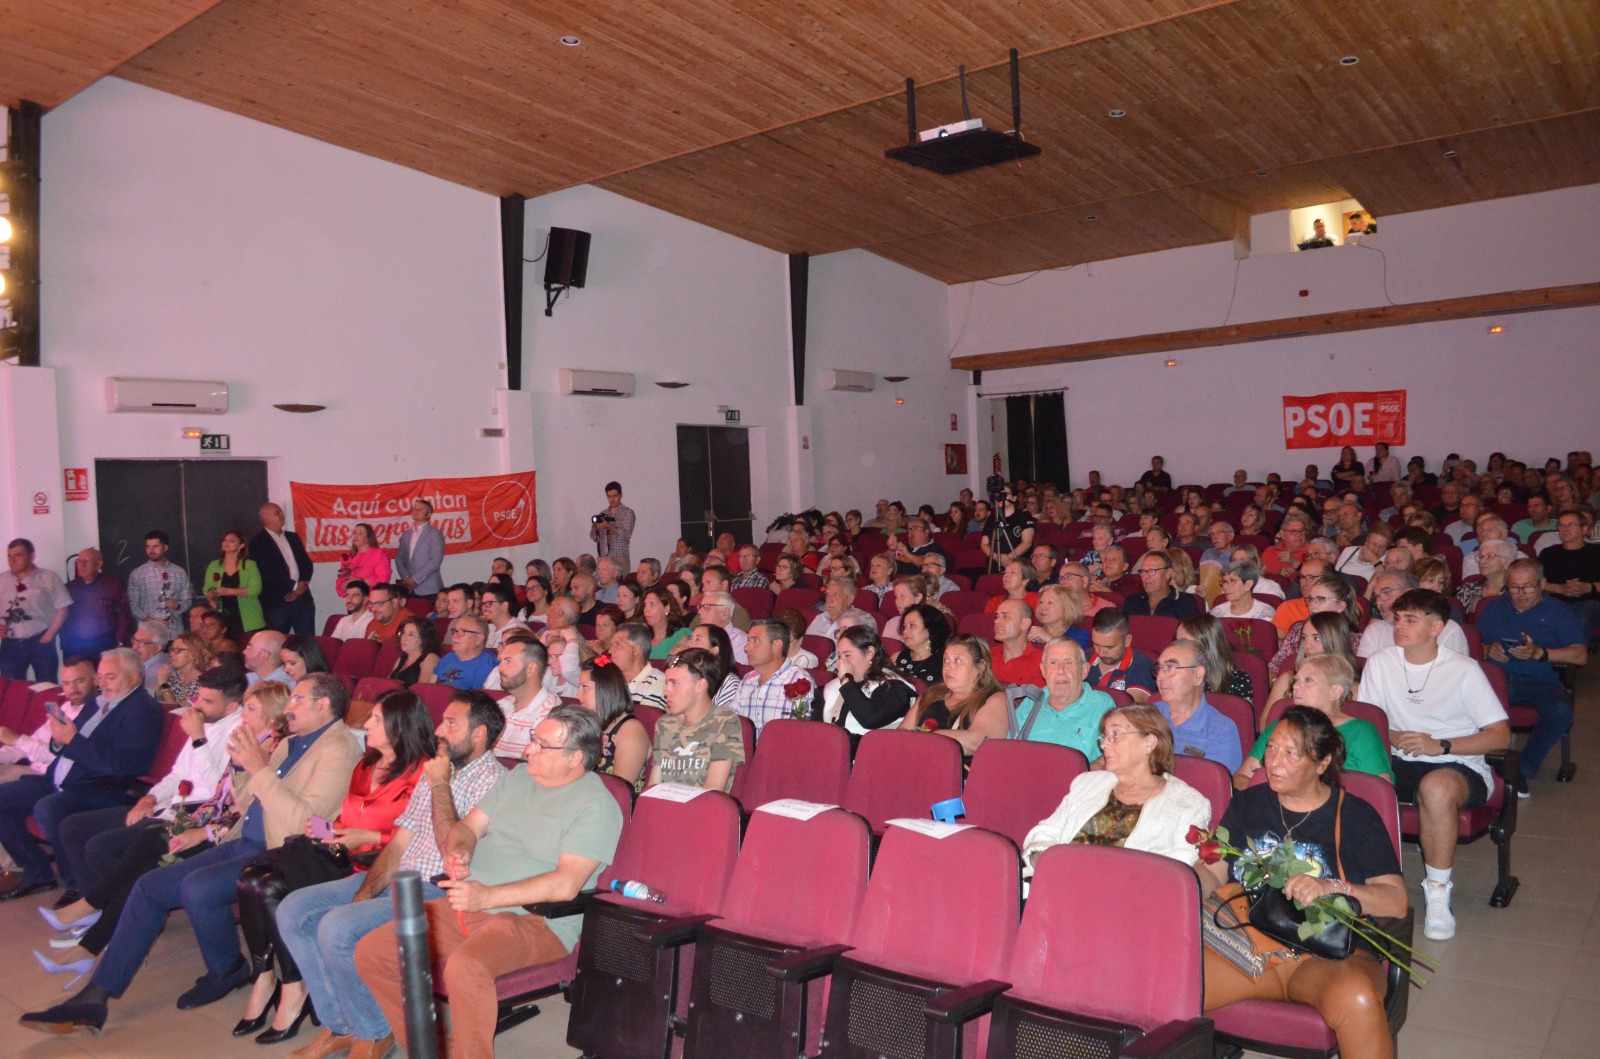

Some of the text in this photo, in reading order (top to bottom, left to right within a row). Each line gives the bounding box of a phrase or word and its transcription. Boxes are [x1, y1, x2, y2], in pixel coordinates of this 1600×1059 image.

[1285, 402, 1374, 439] PSOE
[333, 493, 380, 519] Aquí
[493, 508, 518, 522] PSOE
[314, 518, 353, 547] las
